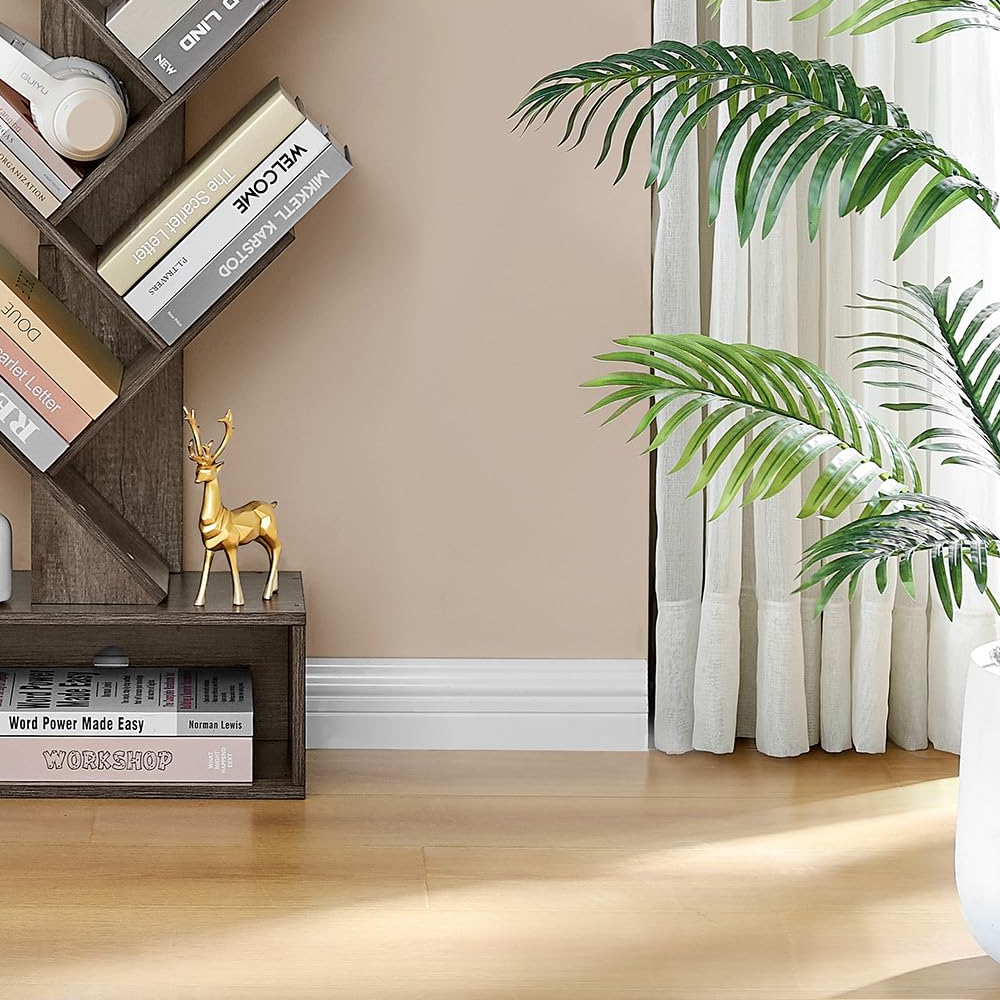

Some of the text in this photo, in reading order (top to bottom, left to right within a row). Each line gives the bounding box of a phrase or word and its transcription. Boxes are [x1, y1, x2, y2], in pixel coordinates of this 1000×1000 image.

[178, 10, 223, 52] LIND
[154, 53, 177, 76] NEW
[20, 72, 48, 95] GUIYU
[232, 143, 308, 214] WELCOME
[131, 167, 236, 265] The Scarlet Letter
[217, 169, 330, 277] MIKKETL KARSTOD
[148, 257, 188, 295] P.L.TRAVERS
[0, 301, 42, 342] DOUE
[24, 376, 62, 413] Letter
[16, 691, 51, 710] Word
[8, 716, 145, 733] Word Power Made Easy
[188, 720, 243, 730] Norman Lewis
[42, 749, 173, 772] WORKSHOP
